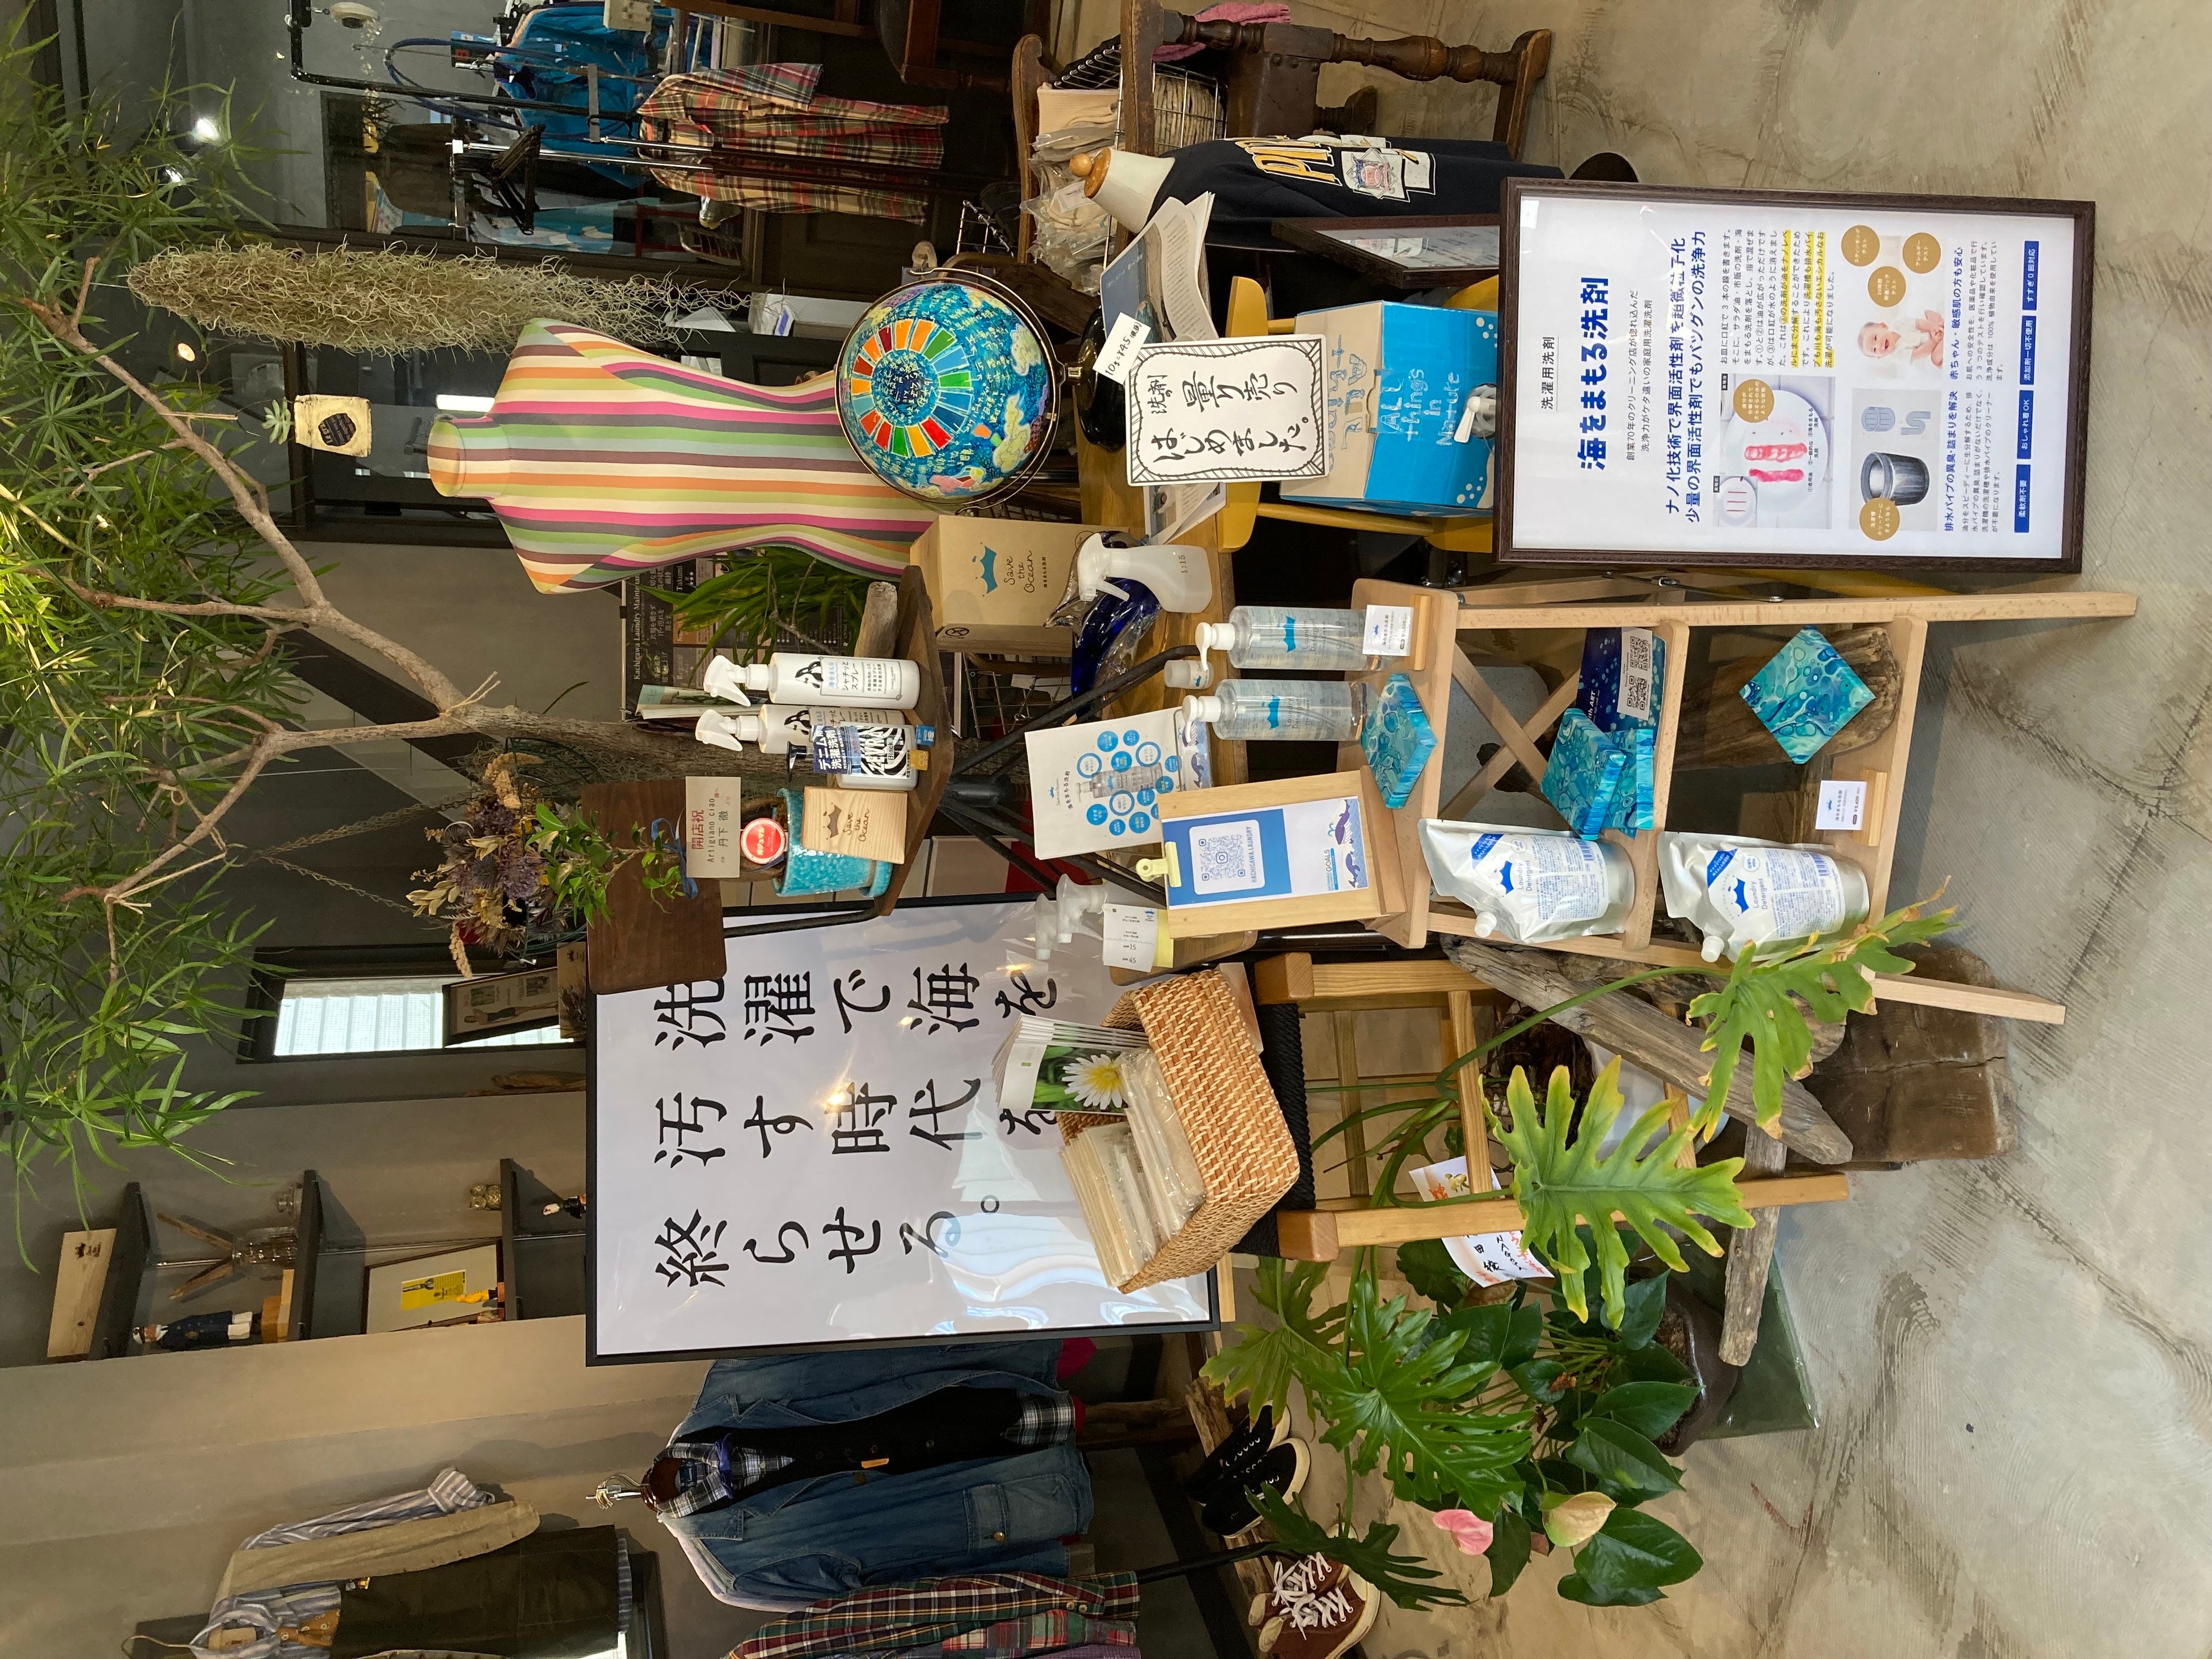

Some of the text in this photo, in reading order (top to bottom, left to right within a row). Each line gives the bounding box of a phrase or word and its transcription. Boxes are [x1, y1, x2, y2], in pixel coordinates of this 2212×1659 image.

[1744, 230, 1754, 365] をまもる洗剤を落とし、指で混ぜま
[1755, 230, 1765, 365] す。①と②は油が広がっただけです
[1767, 230, 1777, 366] が、③は口紅が水のように消えまし
[1779, 230, 1789, 366] た。これは③の洗剤が油をナノレベ
[1791, 231, 1800, 366] ルにまで分解することができたため
[1802, 232, 1812, 366] です。これにより洗濯槽も排水パイ
[1813, 232, 1824, 368] プも川も海も汚さないエシカルなお
[1950, 247, 1964, 380] 赤ちゃん・敏感肌の方も安心
[1966, 240, 1978, 380] お肌への安全性を、医薬品や化粧品で行
[1825, 271, 1834, 368] 洗濯が可能になりました。
[2024, 320, 2033, 381] 添加剤一切不使用
[1182, 371, 1298, 412] 量り売り
[1541, 336, 1555, 410] 洗濯用洗剤
[1577, 277, 1609, 471] 海をまもる洗剤
[1626, 290, 1639, 461] 創業70年のクリーニング店が惚れ込んだ
[1641, 299, 1653, 453] 洗浄力がケタ違いの家庭用洗濯洗剤
[1686, 231, 1706, 523] 少量の界面活性剤でもバツグンの洗浄力
[1424, 399, 1442, 416] in
[1436, 372, 1460, 446] Nature
[1814, 417, 1819, 428] 洗剤
[2020, 399, 2030, 450] おしゃれ着OK
[1151, 416, 1309, 463] はじめました。
[1814, 448, 1819, 458] 洗剤
[1944, 391, 1958, 532] 排水パイプの異臭・詰まりを解決
[1962, 392, 1973, 532] 油分をスピーディーに生分解するため、排
[1982, 392, 1992, 533] 洗濯機の洗濯槽や排水パイプのクリーナー
[2018, 480, 2027, 518] 柔軟剤不要
[1004, 556, 1015, 585] Save
[1023, 550, 1035, 593] Ocean
[1177, 555, 1188, 574] 1:15
[634, 613, 642, 640] Laundry
[1309, 618, 1319, 651] Detergent
[633, 643, 642, 679] Kachigawa
[1284, 698, 1293, 727] Laundry
[1293, 696, 1302, 729] Detergent
[825, 729, 842, 769] 洗濯洗剤
[864, 731, 885, 771] ZEVRA
[1063, 770, 1073, 810] 海をまもる洗剤
[692, 810, 704, 850] 開店祝
[718, 811, 728, 821] 徹
[718, 827, 728, 847] 丹下
[843, 812, 853, 835] Save
[852, 818, 861, 830] the
[858, 809, 869, 842] Ocean
[707, 821, 715, 862] Artigiano
[1750, 881, 1759, 909] Laundry
[1758, 878, 1768, 910] Detergent
[653, 962, 1057, 1051] 洗濯で海を
[653, 1194, 999, 1288] 終らせる。
